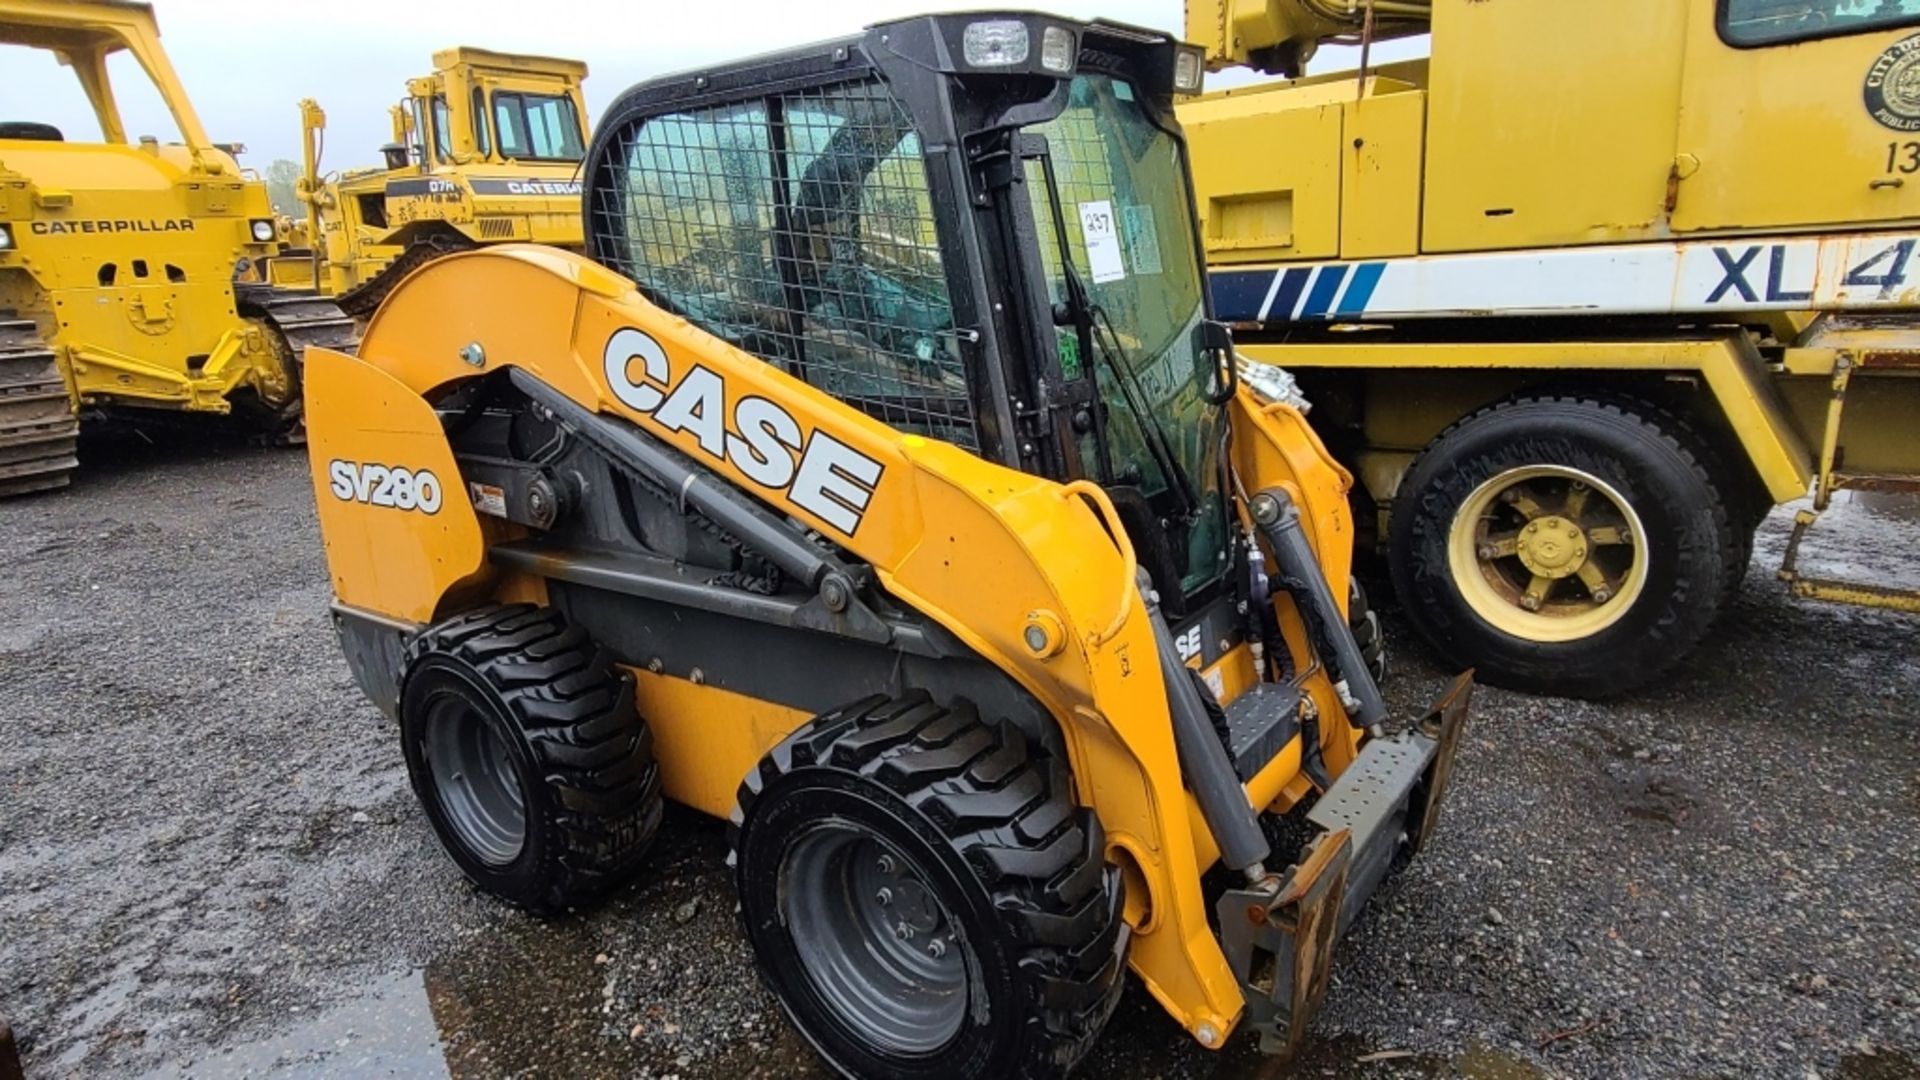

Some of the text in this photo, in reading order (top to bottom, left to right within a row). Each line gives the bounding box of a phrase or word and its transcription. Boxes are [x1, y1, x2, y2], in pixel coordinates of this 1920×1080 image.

[1867, 49, 1896, 88] CITY
[1874, 108, 1920, 130] PUBLIC
[1886, 141, 1920, 174] 13
[31, 219, 195, 235] CATERPILLAR
[1705, 245, 1815, 303] XL
[603, 326, 886, 538] CASE
[330, 459, 442, 515] SV280
